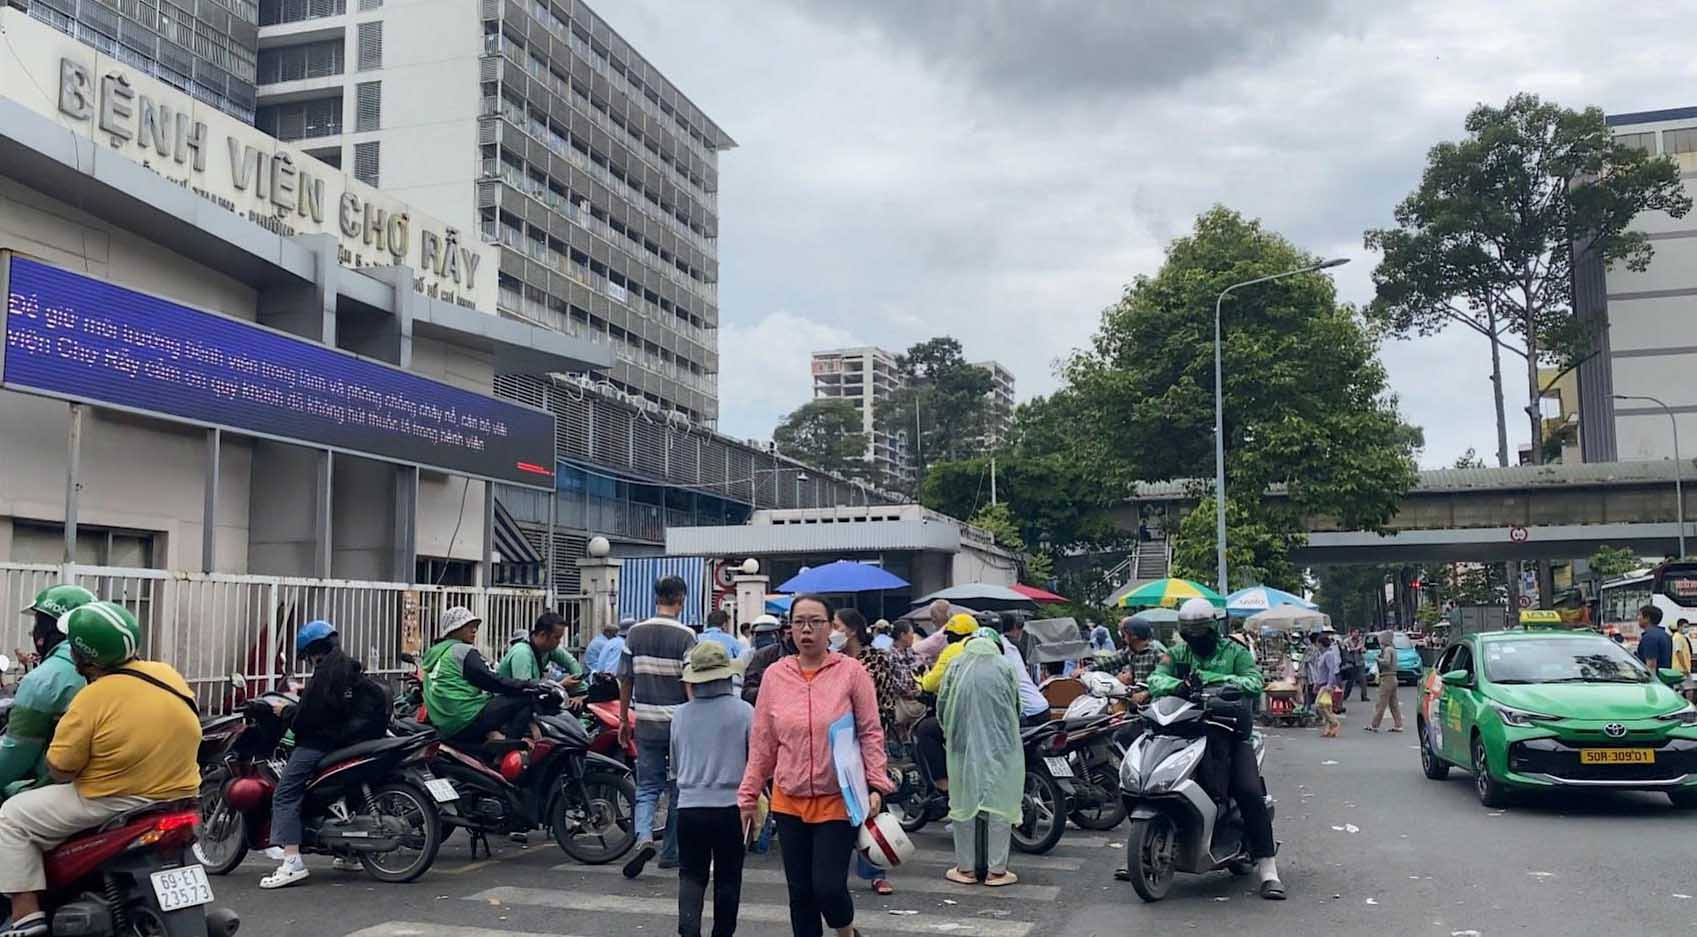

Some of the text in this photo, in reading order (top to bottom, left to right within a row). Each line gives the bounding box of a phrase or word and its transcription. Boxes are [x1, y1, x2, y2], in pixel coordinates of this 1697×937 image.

[58, 57, 480, 290] BỆNH VIỆN CHỢ RẪY
[43, 598, 68, 615] Grab
[74, 635, 98, 657] Grab
[160, 869, 198, 890] 69-E1
[161, 884, 209, 908] 235.73
